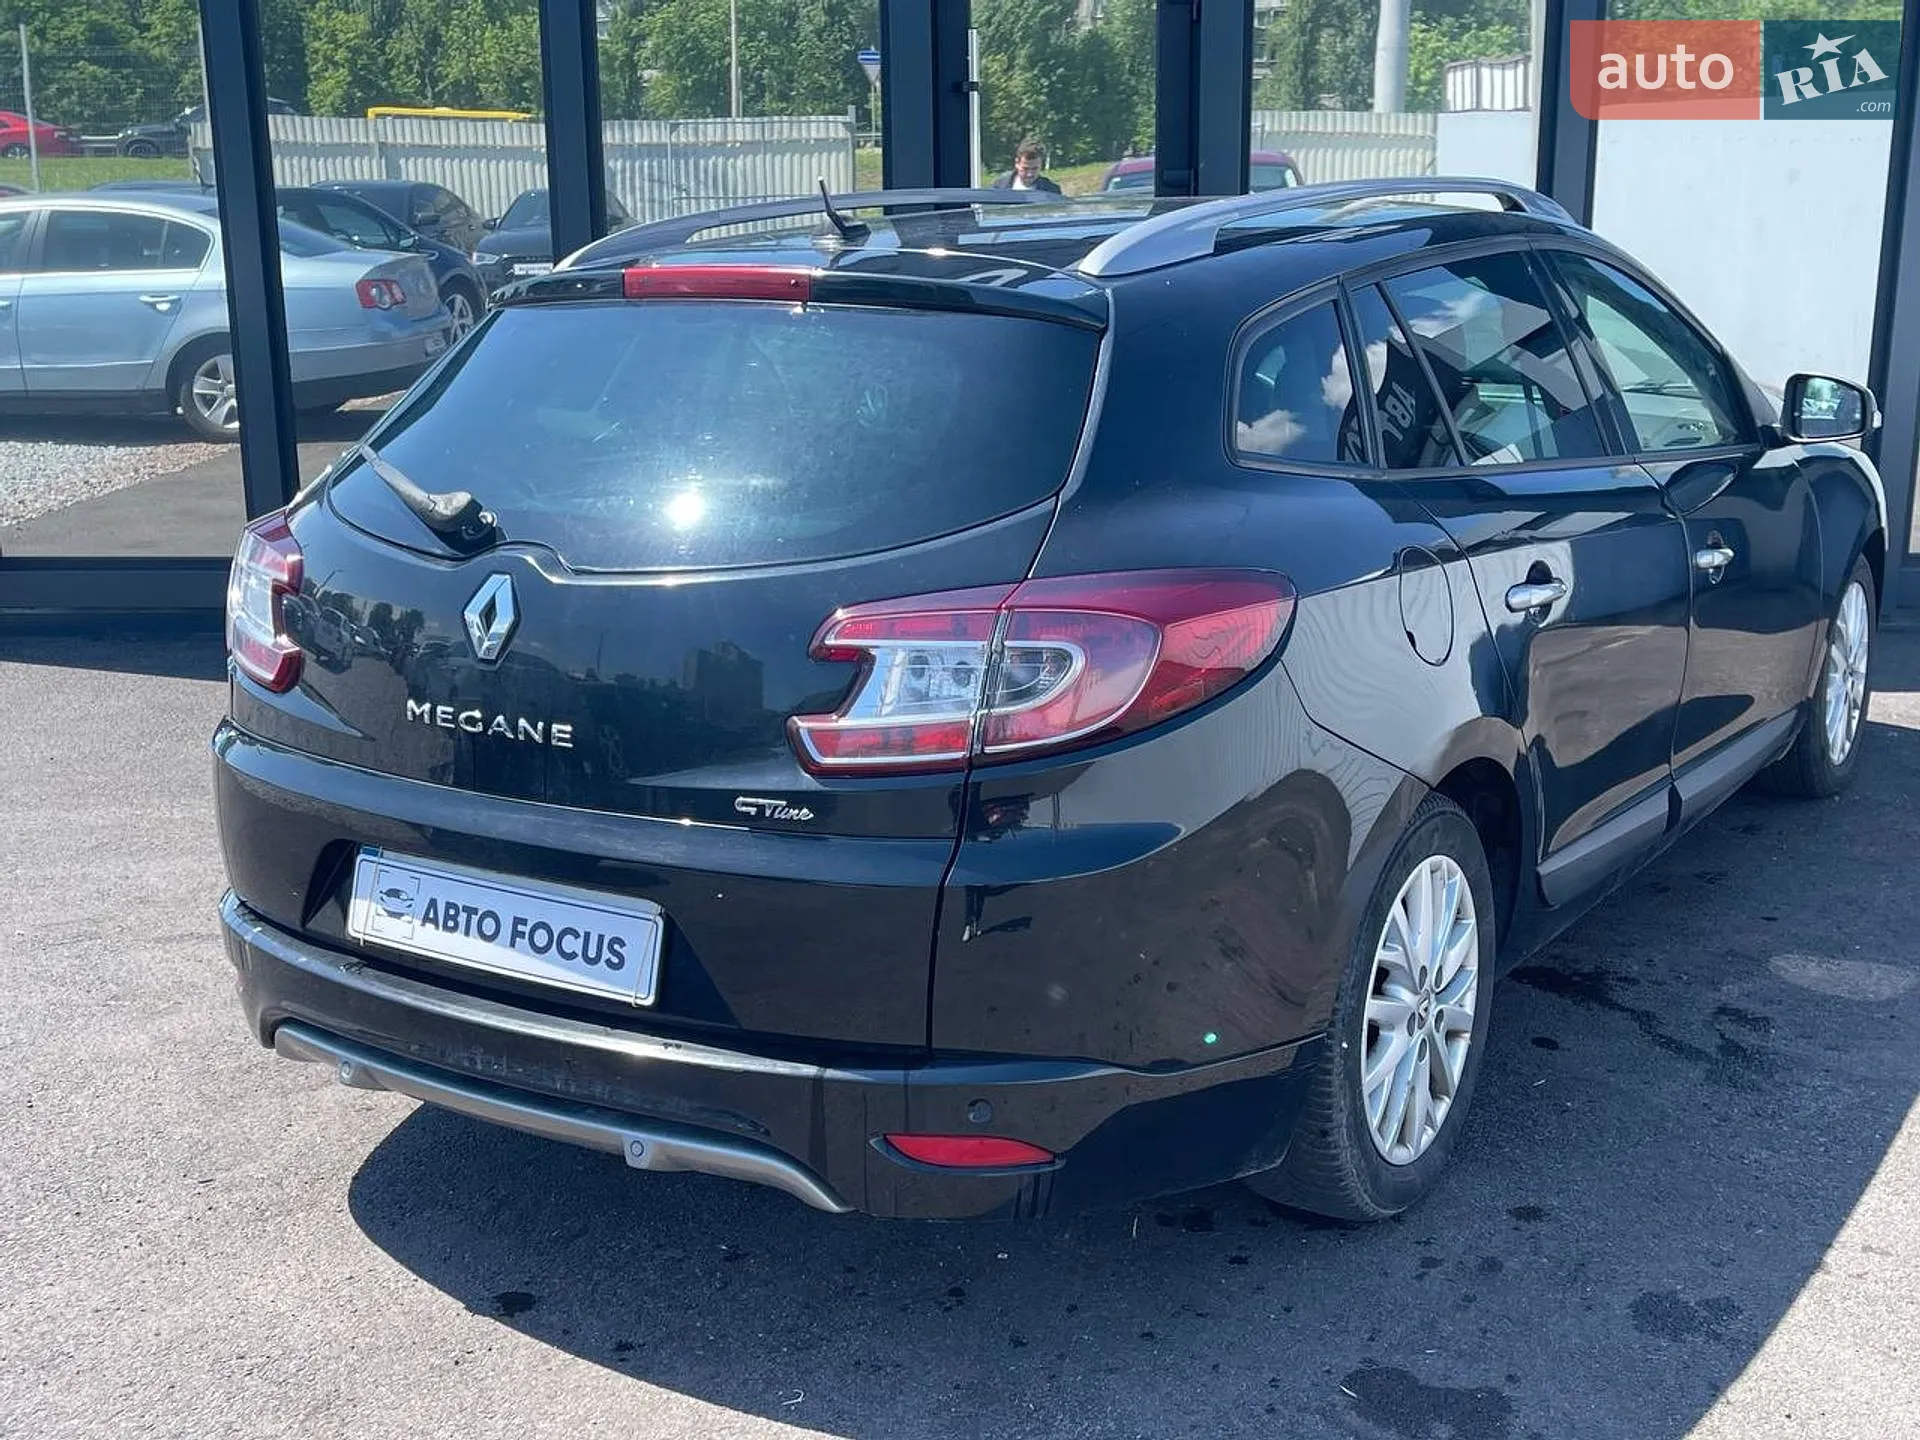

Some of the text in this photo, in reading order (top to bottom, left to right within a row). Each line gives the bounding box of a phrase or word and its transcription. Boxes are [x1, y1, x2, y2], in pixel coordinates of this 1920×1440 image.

[406, 698, 574, 748] MEGANE
[420, 896, 627, 971] АВТО FOCUS
